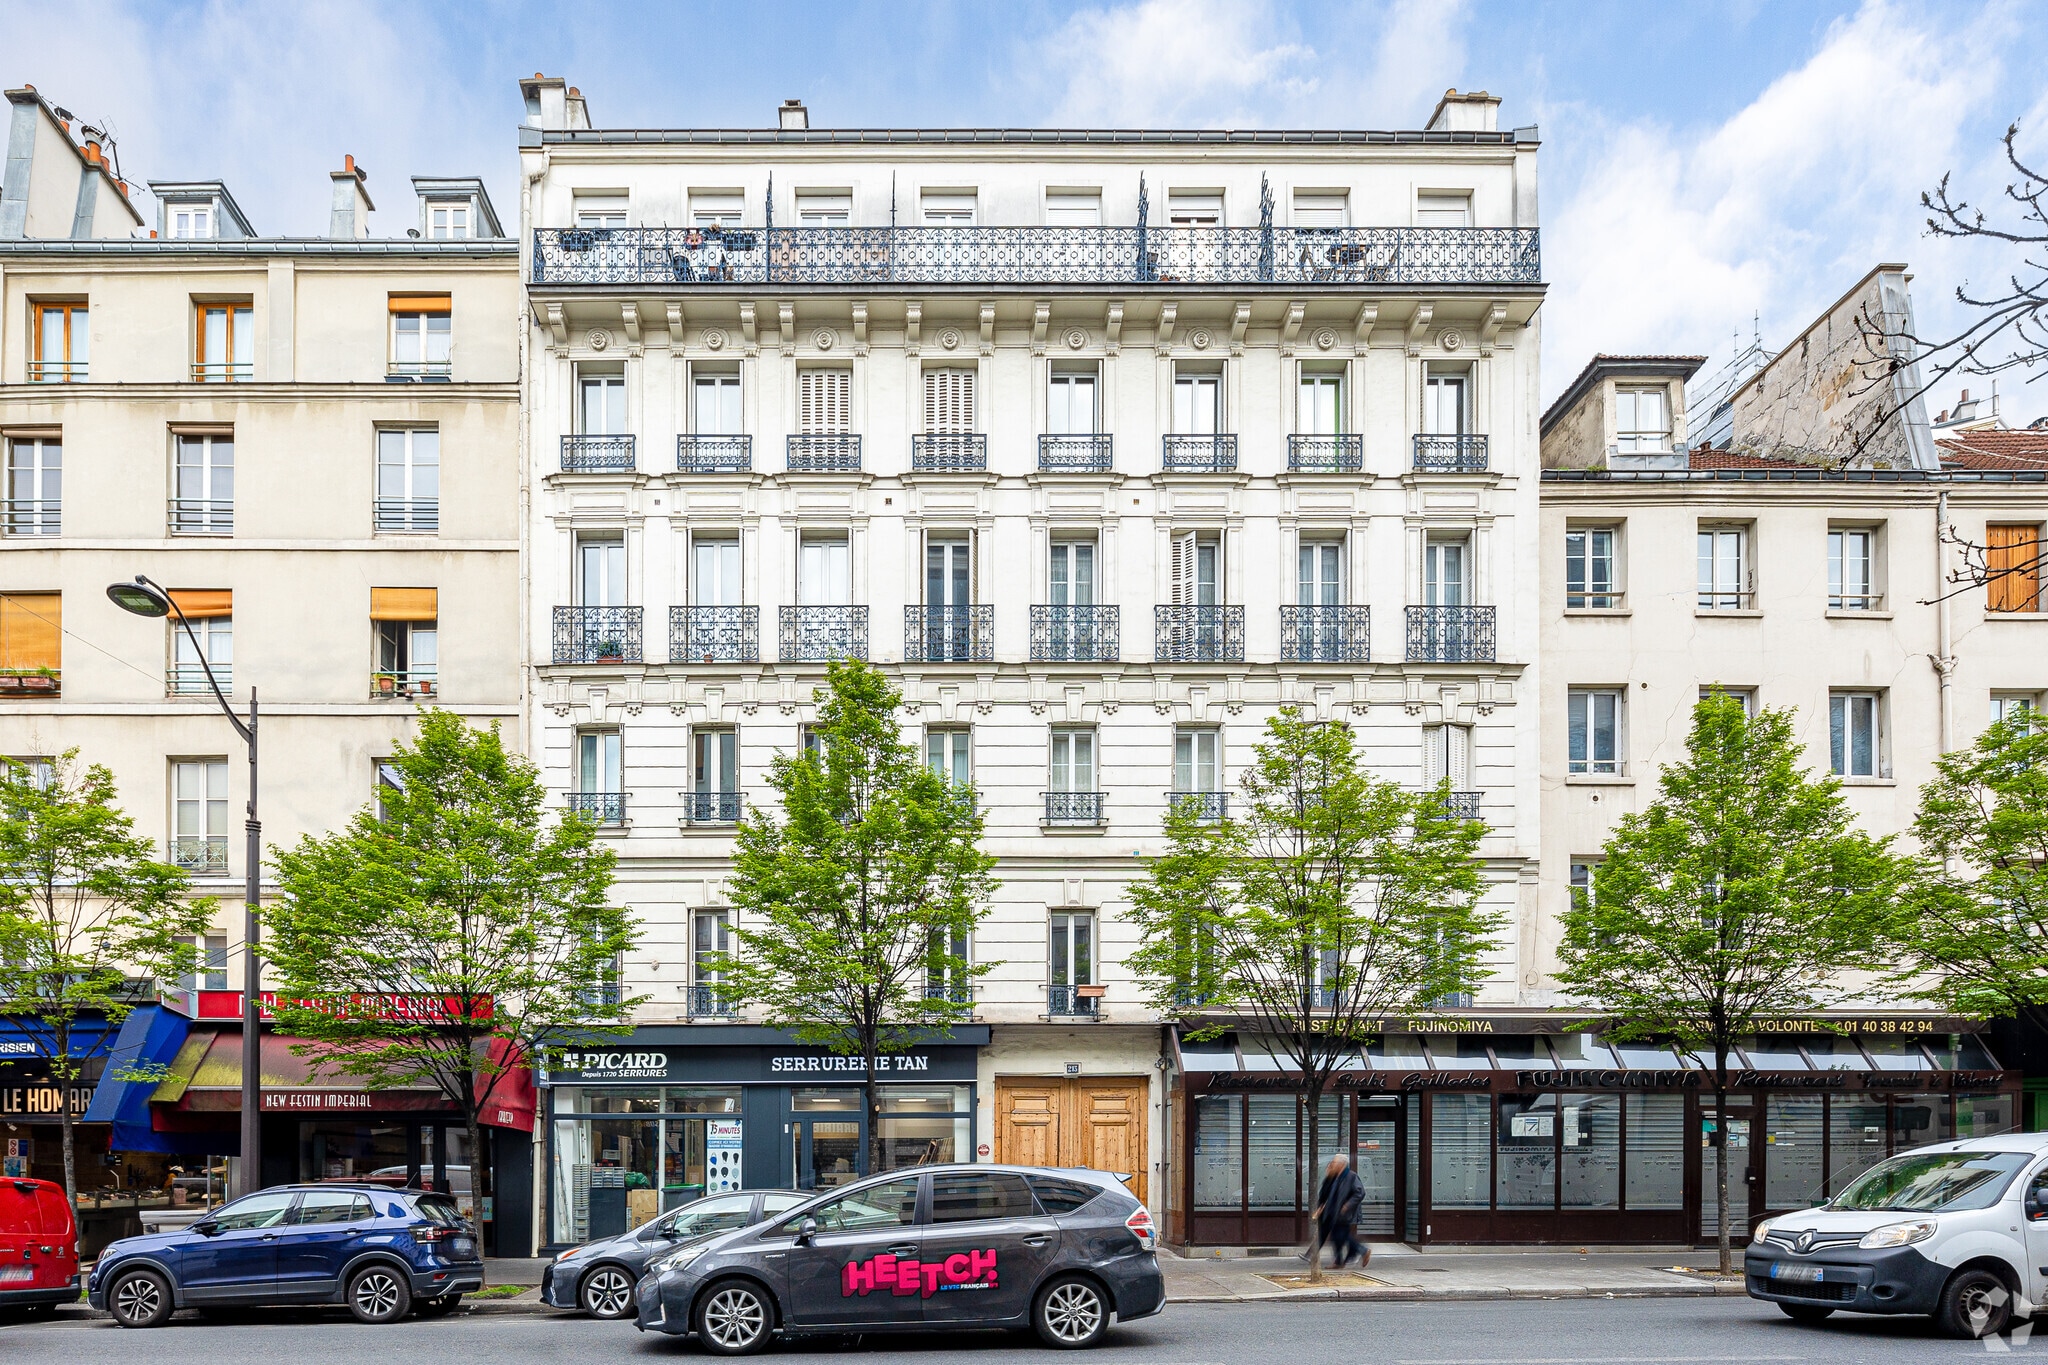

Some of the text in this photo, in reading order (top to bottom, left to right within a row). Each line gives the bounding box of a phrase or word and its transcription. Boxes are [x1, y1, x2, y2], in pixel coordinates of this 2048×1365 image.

[1408, 1020, 1494, 1032] FUJINOMIYA
[1758, 1020, 1819, 1032] VOLONTE
[1844, 1020, 1857, 1032] 01
[1862, 1020, 1877, 1032] 40
[1880, 1020, 1896, 1032] 38
[1899, 1020, 1914, 1032] 42
[1918, 1020, 1933, 1032] 94
[582, 1053, 668, 1069] PICARD
[894, 1056, 929, 1071] TAN
[581, 1071, 602, 1079] Depuis
[618, 1069, 668, 1077] SERRURES
[1515, 1070, 1702, 1088] FUJINOMIYA
[1734, 1070, 1847, 1088] Restaurant
[1332, 1072, 1388, 1089] Sushi
[1401, 1072, 1492, 1091] Grillades
[3, 1088, 97, 1112] LE HOMAR
[266, 1094, 372, 1107] NEW FESTIN IMPERIAL
[718, 1126, 741, 1135] MINUTES
[960, 1282, 989, 1290] FRANÇAIS
